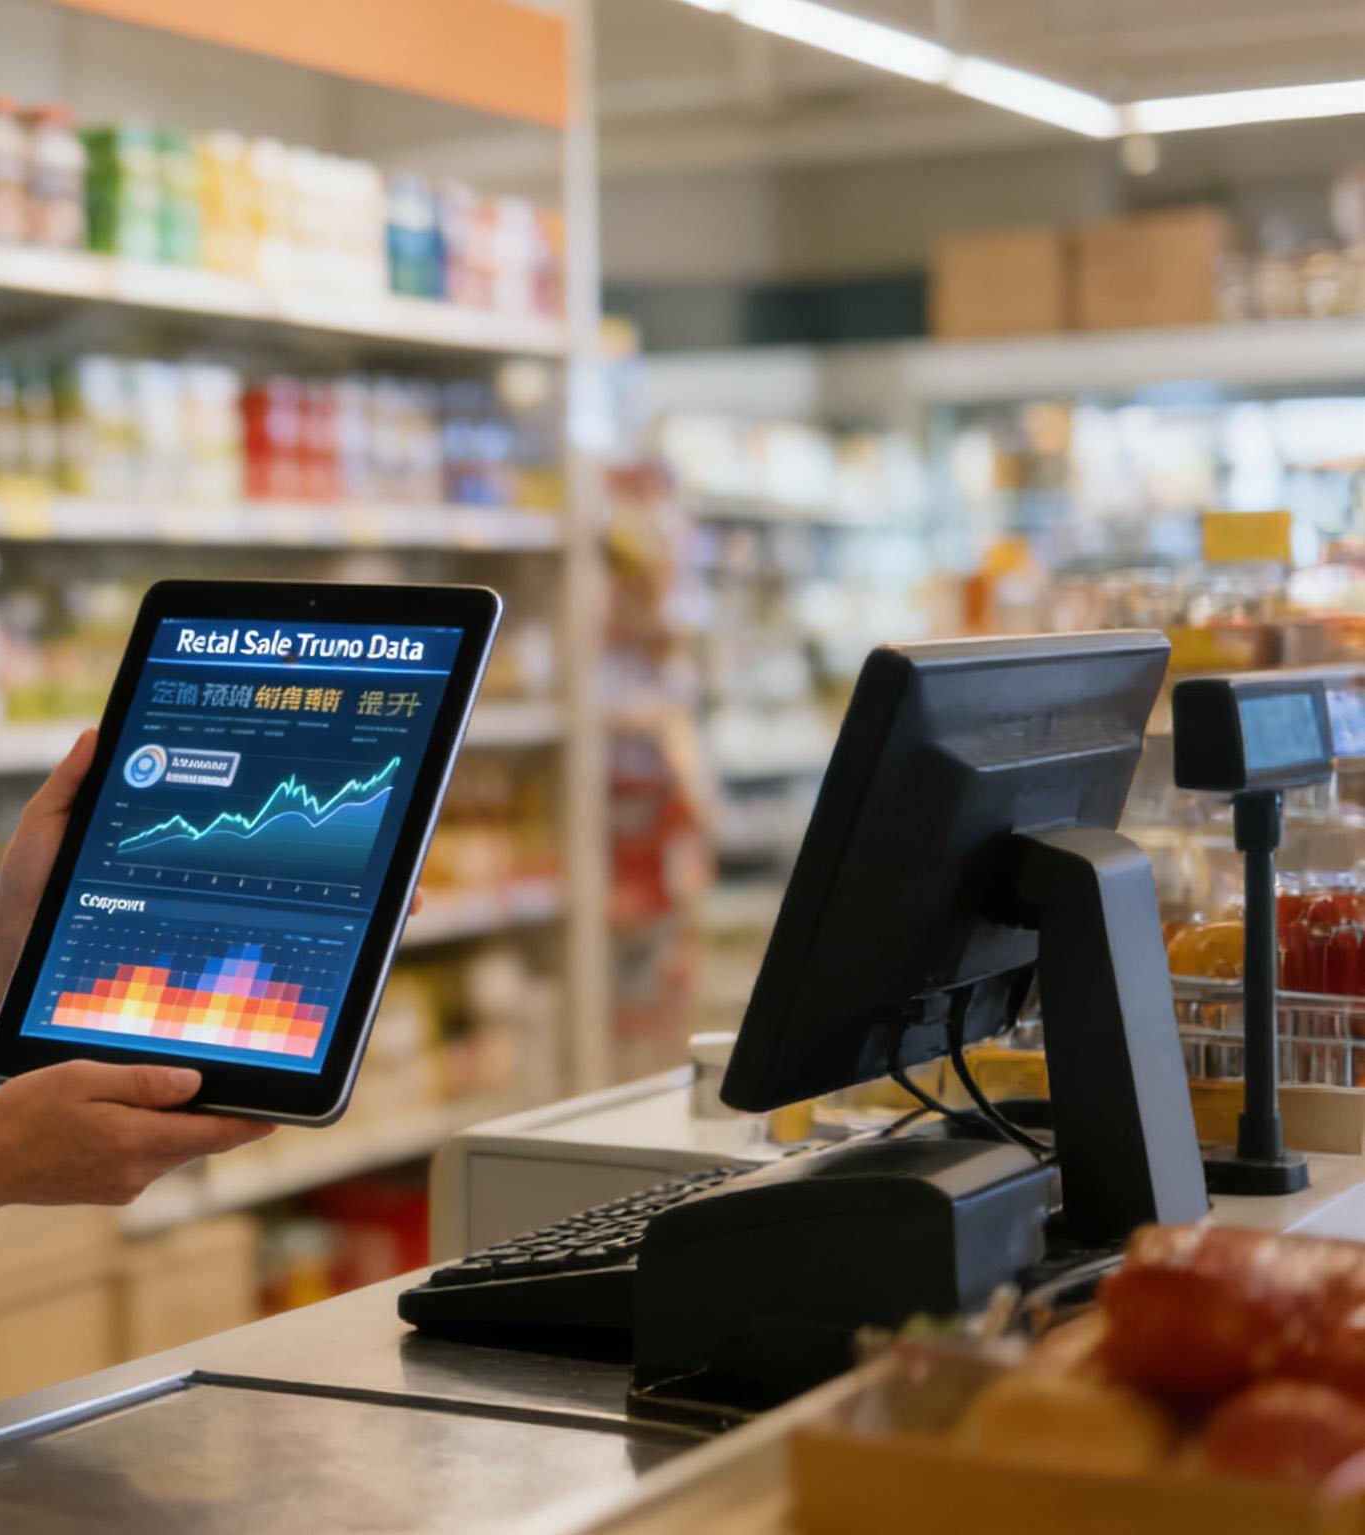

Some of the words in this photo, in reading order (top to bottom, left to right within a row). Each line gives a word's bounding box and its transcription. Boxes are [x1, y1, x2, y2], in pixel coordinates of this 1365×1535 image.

[176, 629, 239, 654] Retal
[240, 630, 292, 656] Sale
[367, 634, 424, 660] Data
